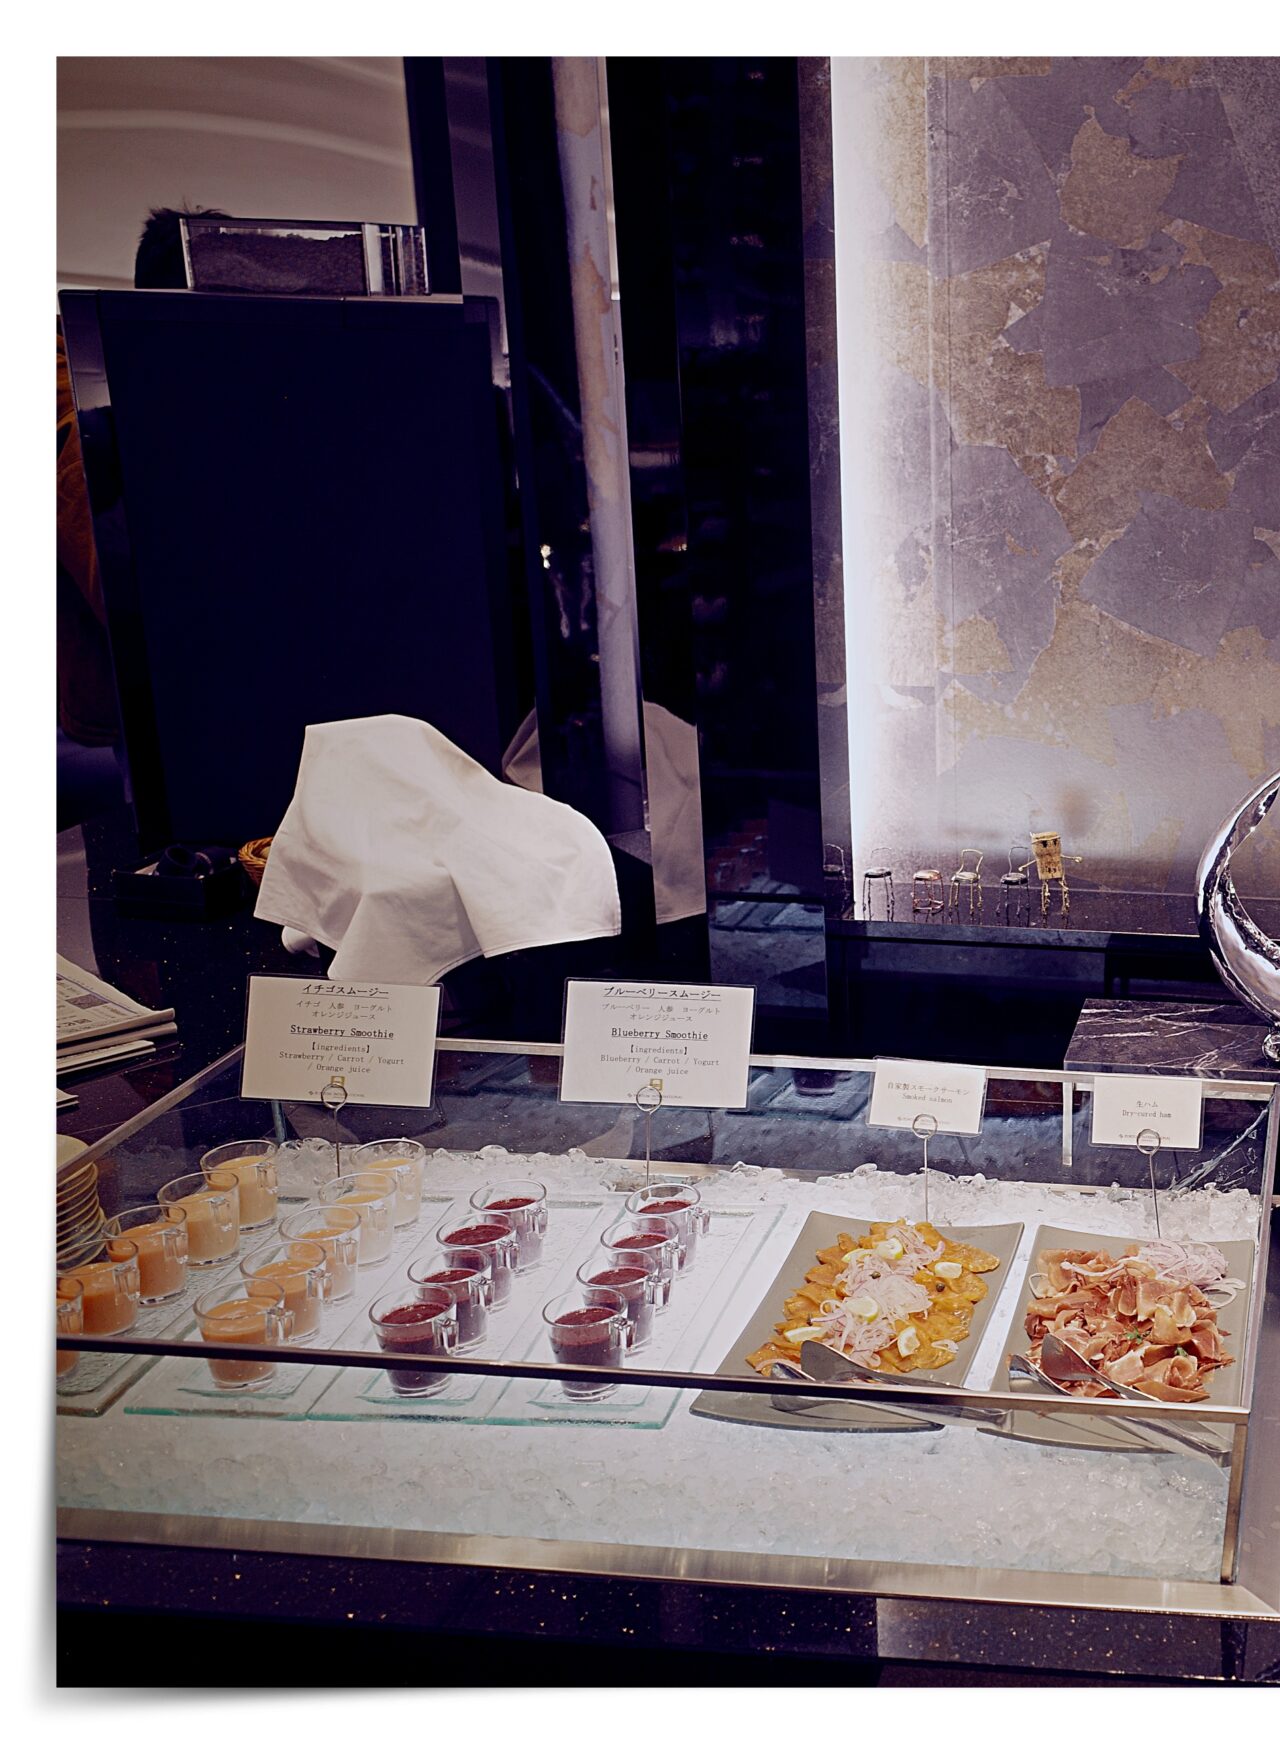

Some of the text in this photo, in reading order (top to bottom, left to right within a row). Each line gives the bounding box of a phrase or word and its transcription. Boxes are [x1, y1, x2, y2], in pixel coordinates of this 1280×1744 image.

[302, 983, 390, 998] イチゴスムージー
[603, 985, 721, 1000] ブルーベリースムージー
[296, 1000, 392, 1012] イチゴ 人参 ヨーグルト
[601, 1003, 721, 1015] ブルーベリー 人参 ヨーグルト
[312, 1010, 376, 1020] オレンジジュース
[630, 1013, 693, 1022] オレンジジュース
[290, 1024, 394, 1039] Strawberry Smoothie
[611, 1028, 708, 1041] Blueberry Smoothie
[279, 1051, 325, 1061] Strawberry
[337, 1054, 365, 1063] Carrot
[377, 1056, 404, 1065] Yogurt
[600, 1054, 641, 1065] Blueberry
[653, 1056, 680, 1065] Carrot
[693, 1058, 719, 1067] Yogurt
[316, 1064, 344, 1073] Orange
[348, 1064, 371, 1074] juice
[635, 1066, 662, 1075] Orange
[666, 1067, 689, 1076] juice
[902, 1092, 953, 1104] Smoked salmon
